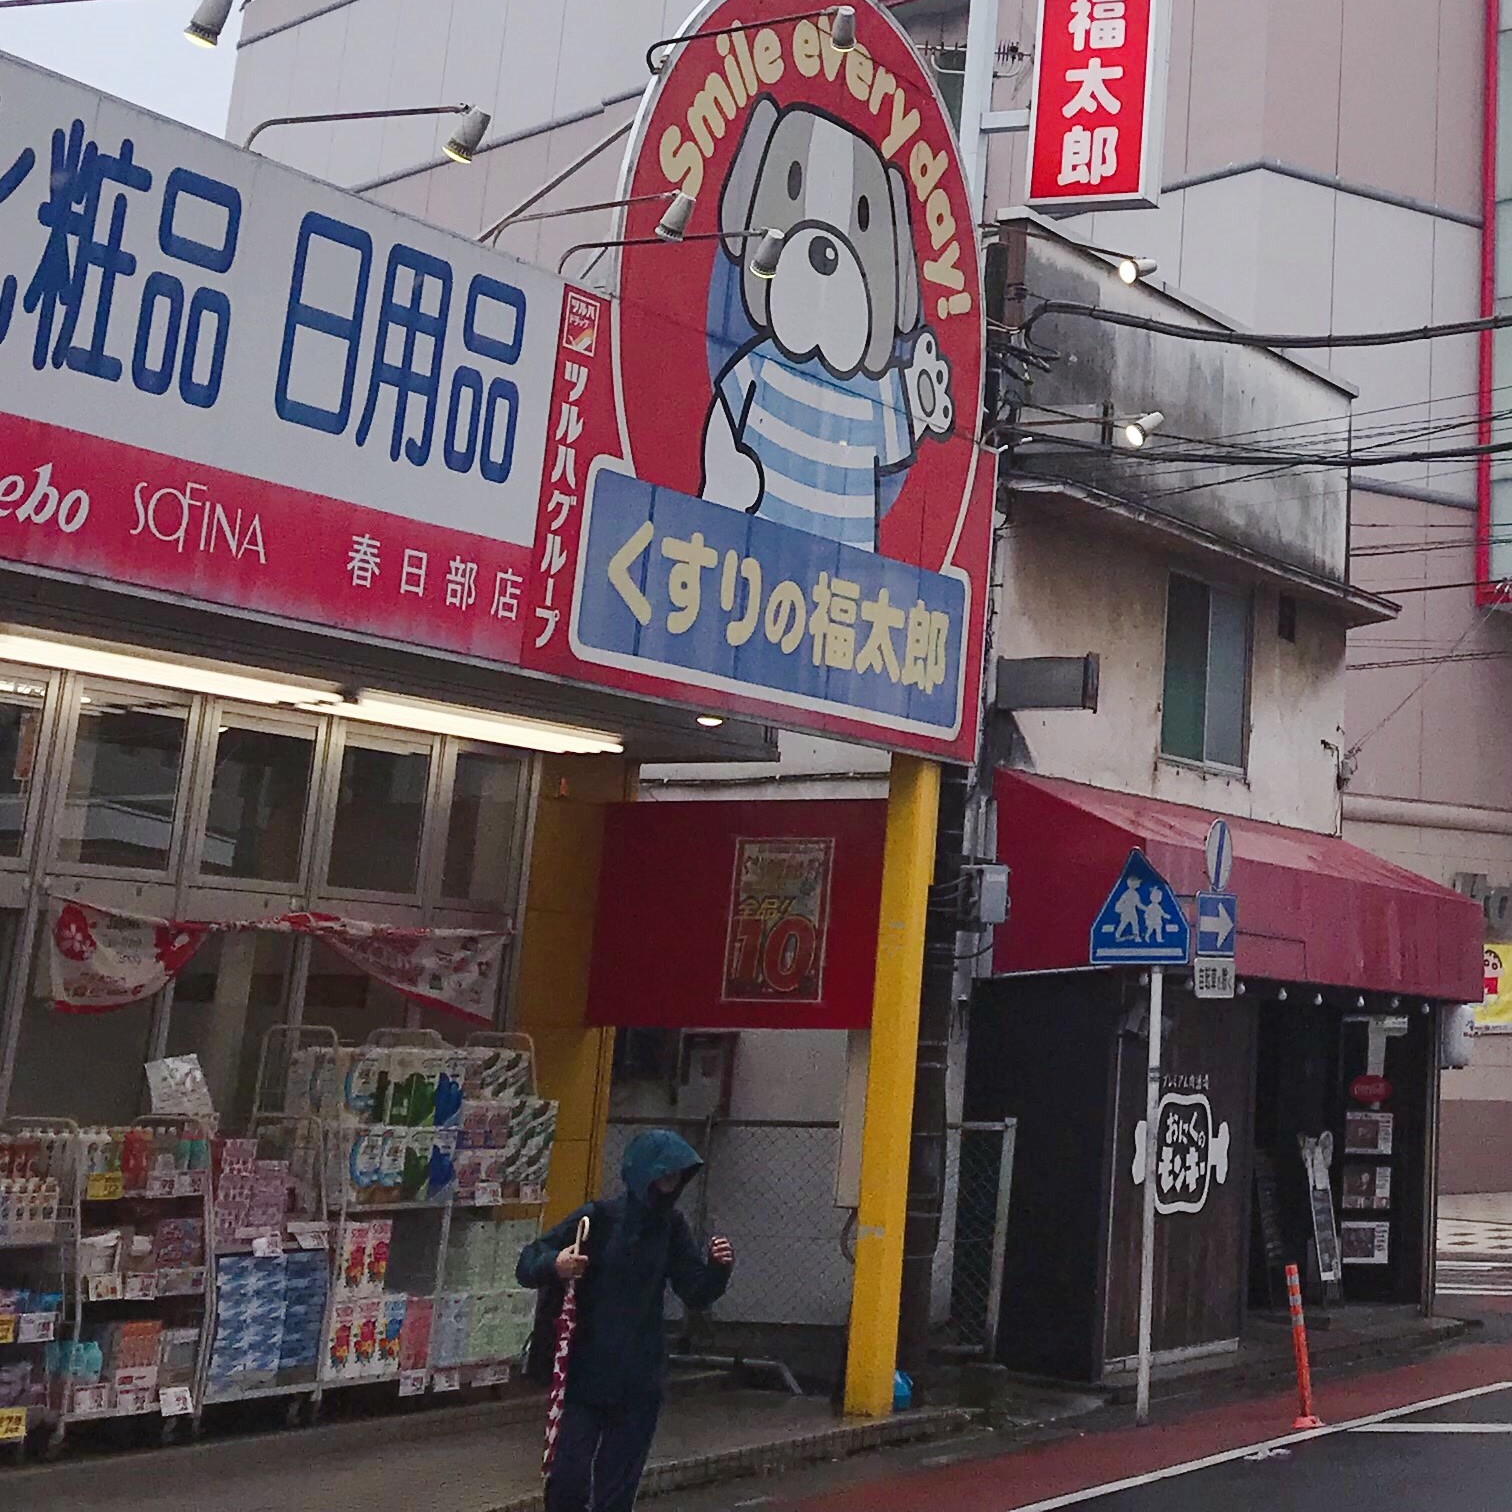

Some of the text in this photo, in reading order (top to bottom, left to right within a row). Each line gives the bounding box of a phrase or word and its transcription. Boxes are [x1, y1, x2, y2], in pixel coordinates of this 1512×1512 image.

[659, 25, 785, 194] Smile
[909, 140, 973, 320] day!
[274, 210, 528, 485] 日用品
[130, 481, 268, 566] SOFINA
[347, 532, 526, 623] 春日部店
[533, 360, 591, 651] ツルハグループ
[606, 519, 947, 696] くすりの福太郎
[1158, 1146, 1206, 1193] モンキー
